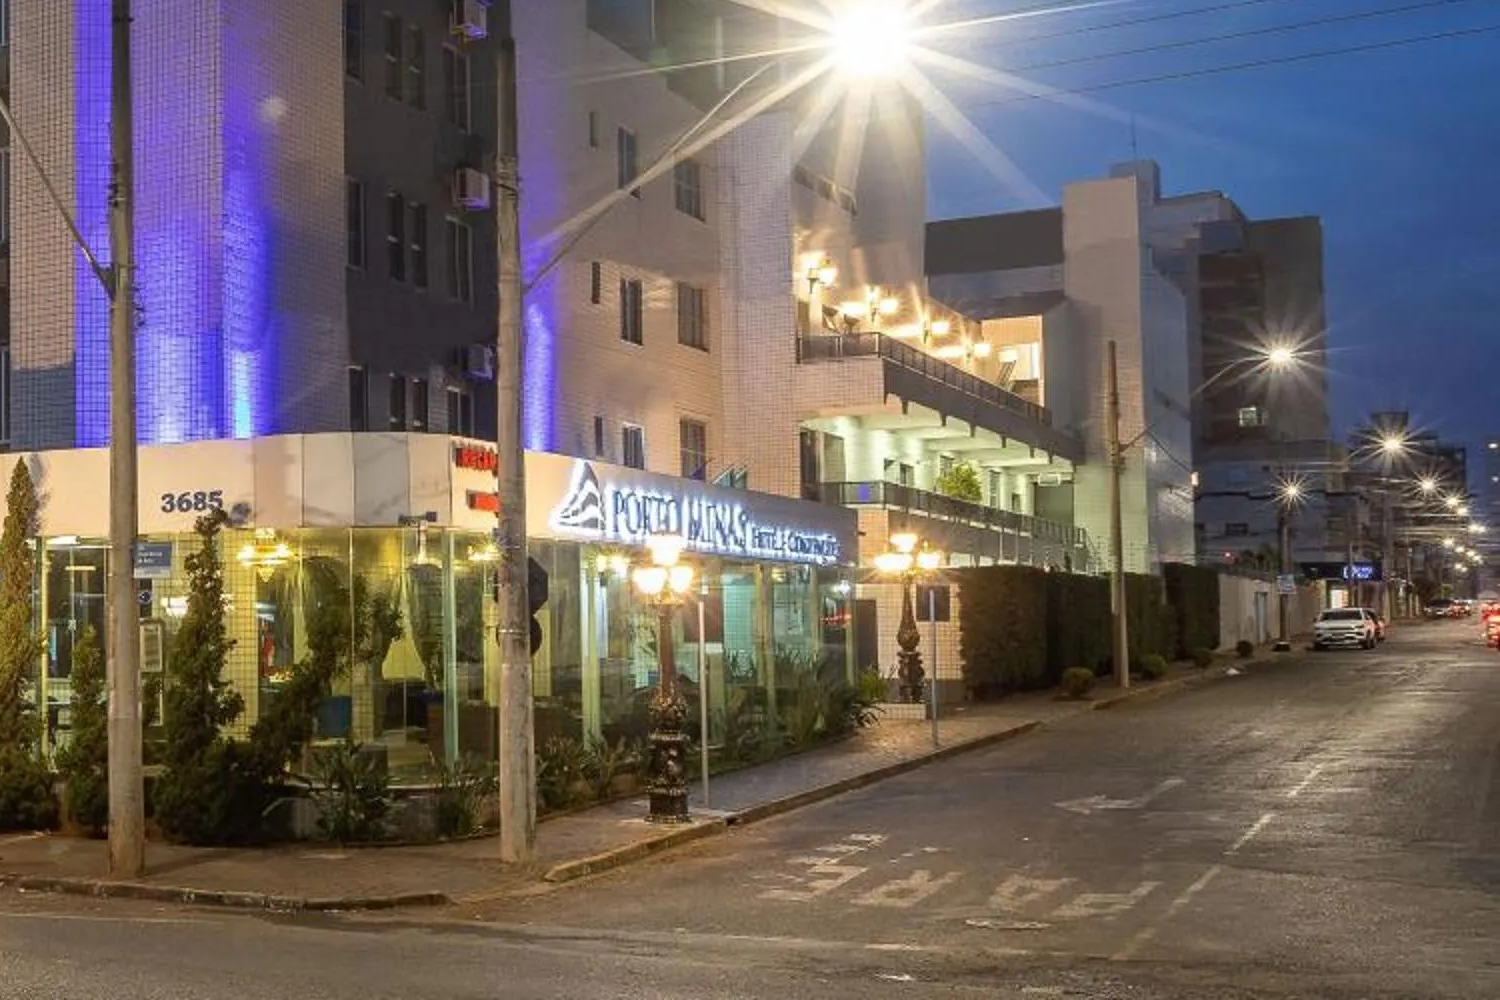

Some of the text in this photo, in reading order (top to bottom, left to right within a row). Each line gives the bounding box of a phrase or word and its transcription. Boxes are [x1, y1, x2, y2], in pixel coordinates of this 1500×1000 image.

[161, 489, 223, 513] 3685
[611, 488, 681, 537] PORTO
[686, 497, 749, 550] MINAS
